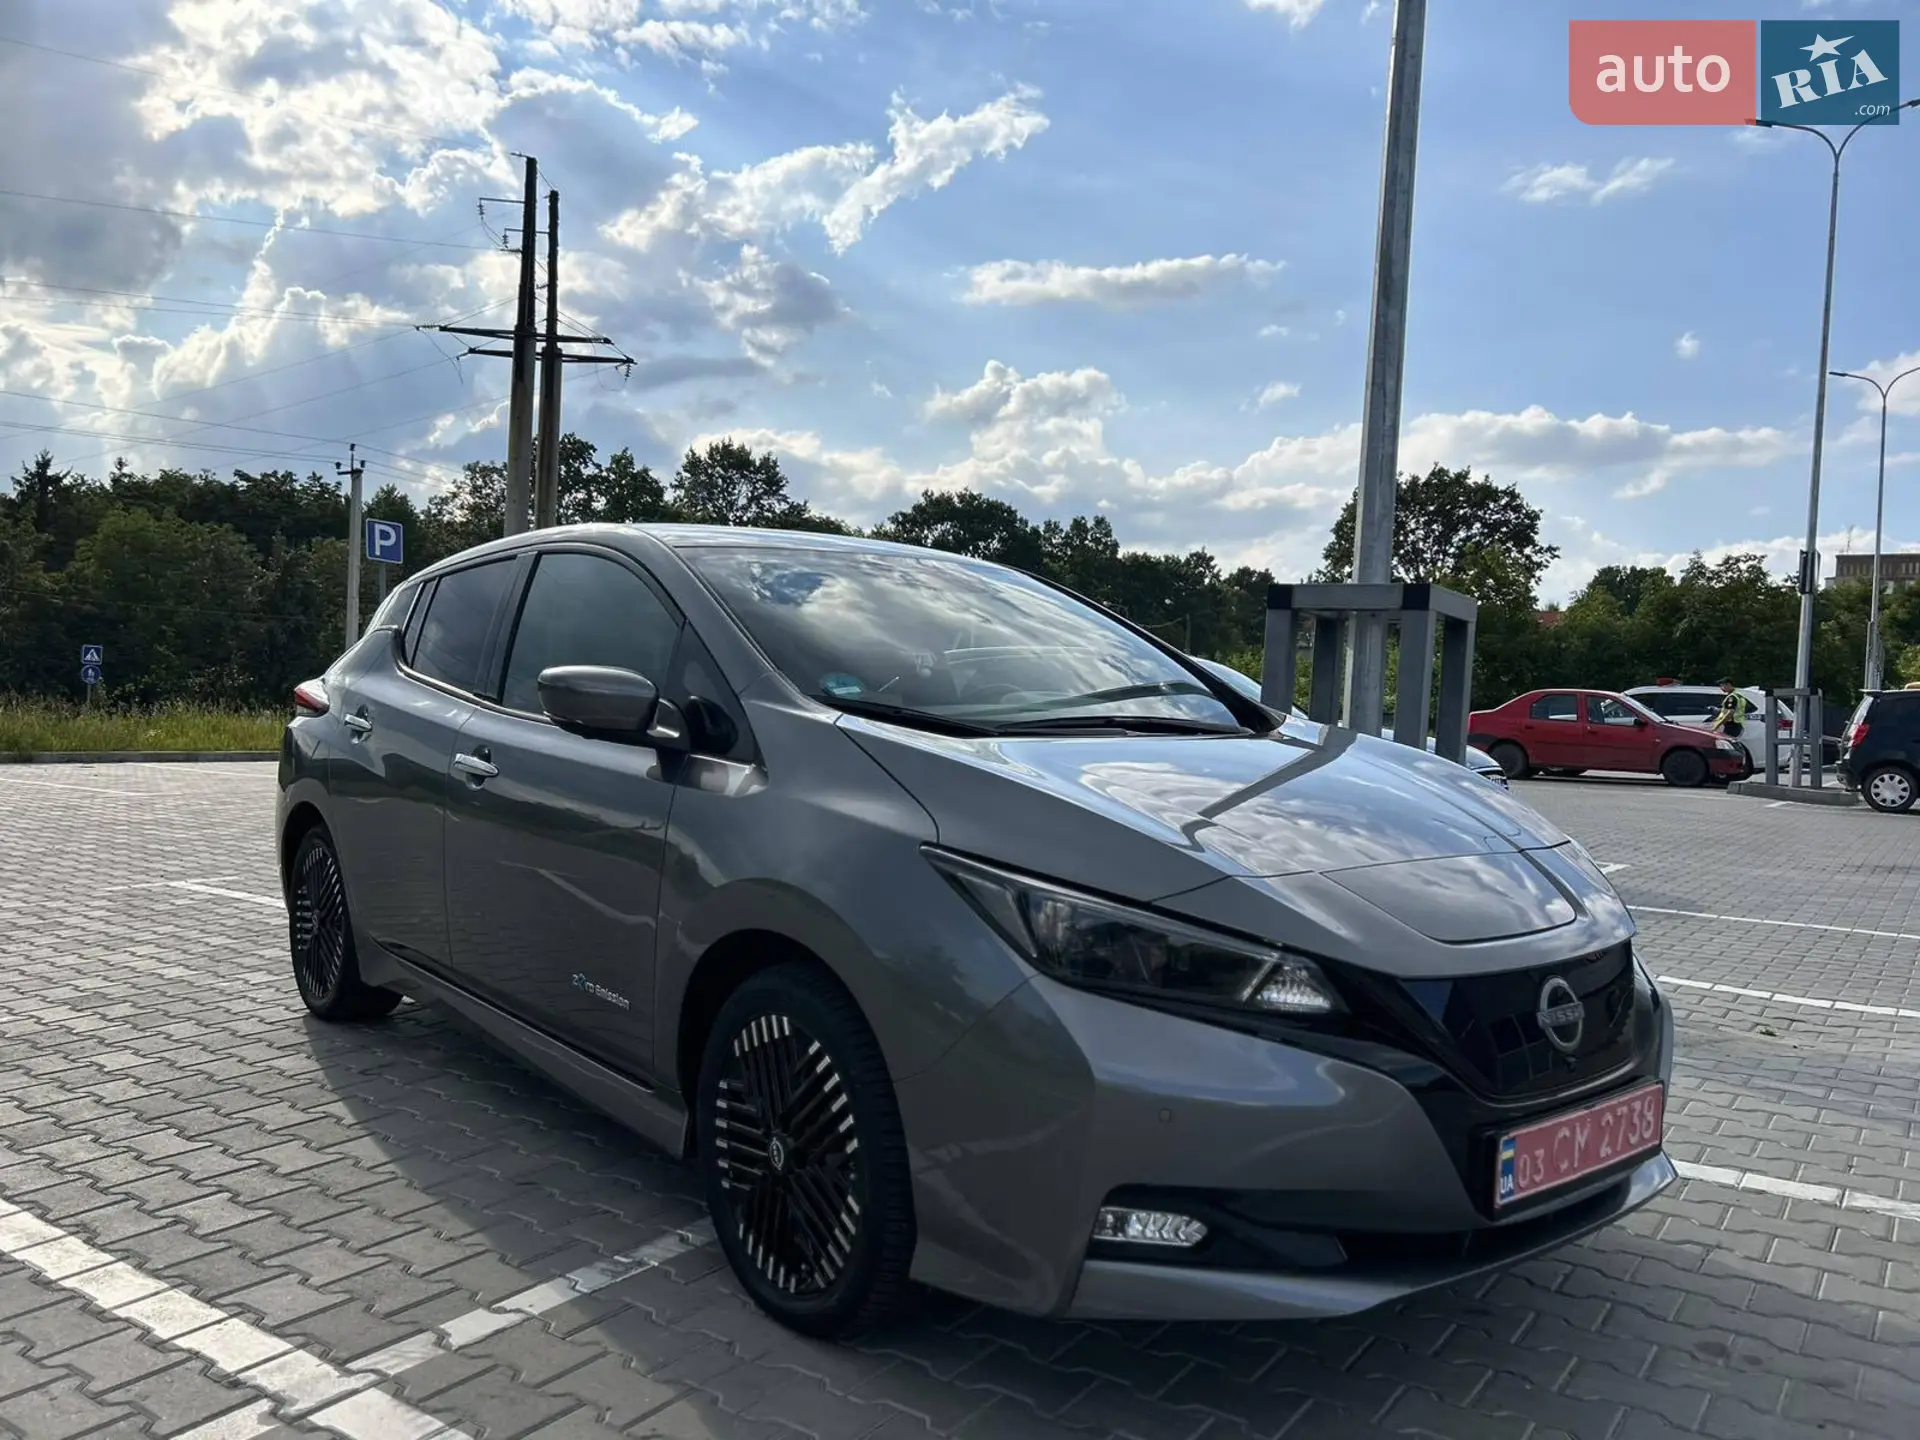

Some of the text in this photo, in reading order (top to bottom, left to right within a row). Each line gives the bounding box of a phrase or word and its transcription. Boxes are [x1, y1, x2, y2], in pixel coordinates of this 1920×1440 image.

[374, 523, 397, 556] P
[1538, 1004, 1581, 1027] NISS
[1518, 1148, 1545, 1189] 03
[1600, 1096, 1655, 1159] 2738
[1500, 1175, 1514, 1194] UA
